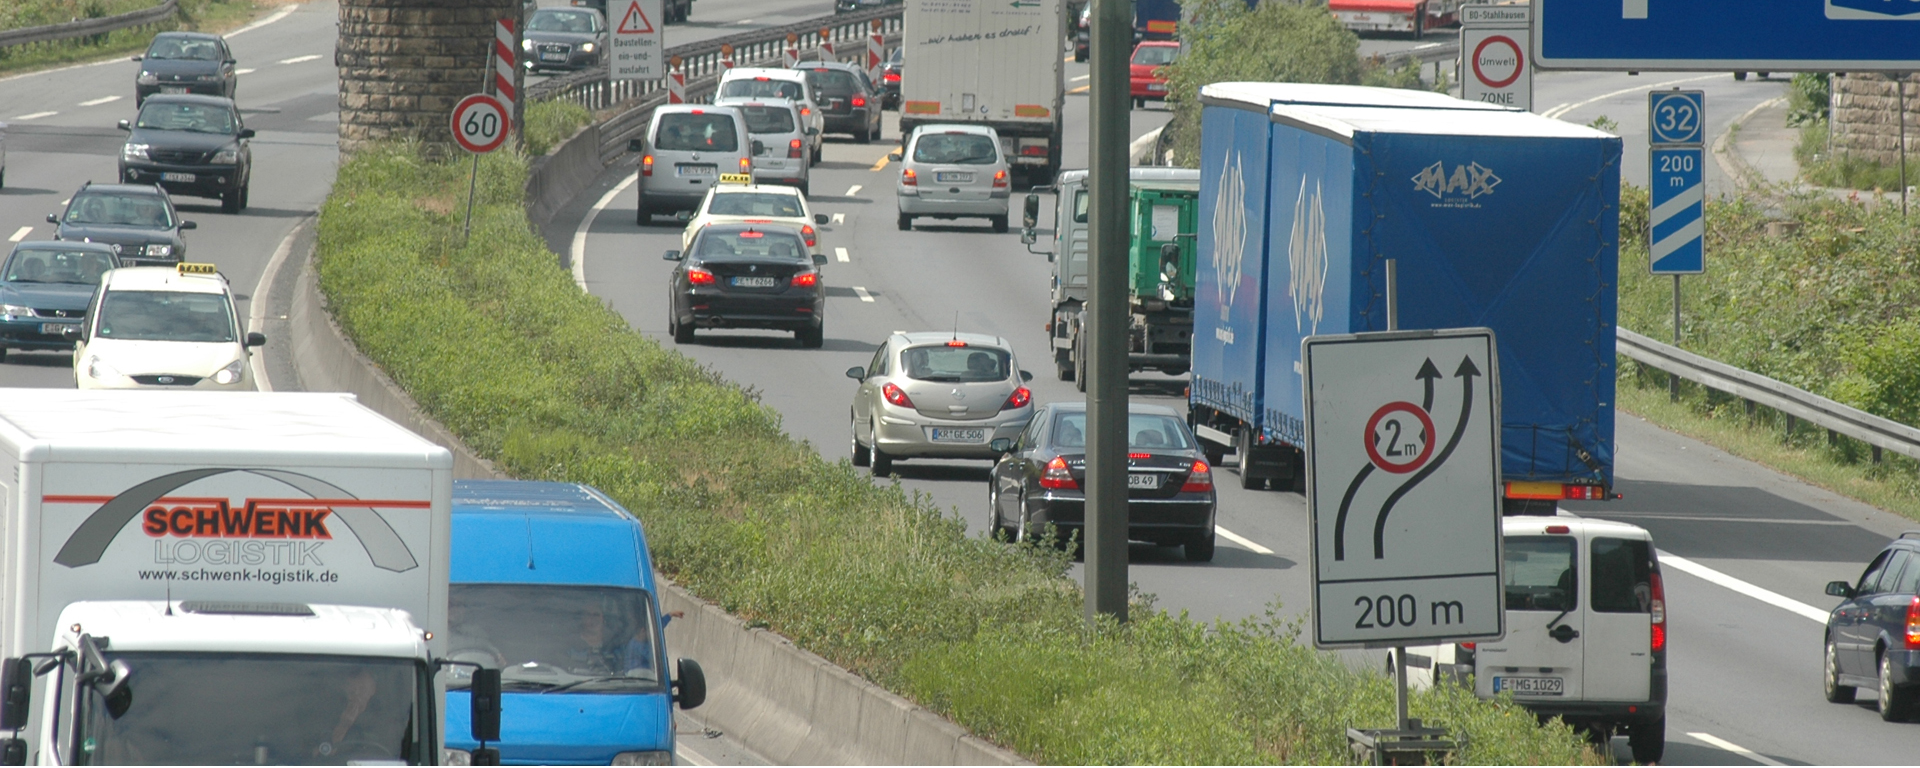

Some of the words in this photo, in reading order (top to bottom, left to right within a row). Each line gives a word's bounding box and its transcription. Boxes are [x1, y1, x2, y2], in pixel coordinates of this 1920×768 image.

[1469, 10, 1525, 19] BO-Stahlhausen
[948, 33, 981, 43] haben
[999, 25, 1032, 38] drauf
[614, 38, 656, 47] Baustellen-
[1480, 57, 1515, 66] Umwelt
[619, 65, 649, 74] ausfahrt
[1480, 92, 1514, 104] ZONE
[465, 111, 497, 138] 60
[1661, 105, 1693, 131] 32
[1661, 155, 1693, 172] 200
[1413, 164, 1494, 194] MAX
[1670, 176, 1684, 187] m
[183, 265, 211, 274] TAXI
[937, 431, 949, 439] KR
[954, 431, 965, 439] GE
[967, 431, 983, 439] 506
[1385, 419, 1402, 457] 2
[1405, 443, 1417, 456] m
[1142, 475, 1154, 485] 49
[145, 501, 330, 536] SCHWENK
[154, 539, 324, 566] LOGISTIK
[138, 568, 339, 585] www.schwenk-logistik.de
[1354, 594, 1416, 629] 200
[1431, 600, 1463, 625] m
[1501, 679, 1508, 690] E
[1516, 679, 1531, 690] MG
[1533, 679, 1561, 691] 1029
